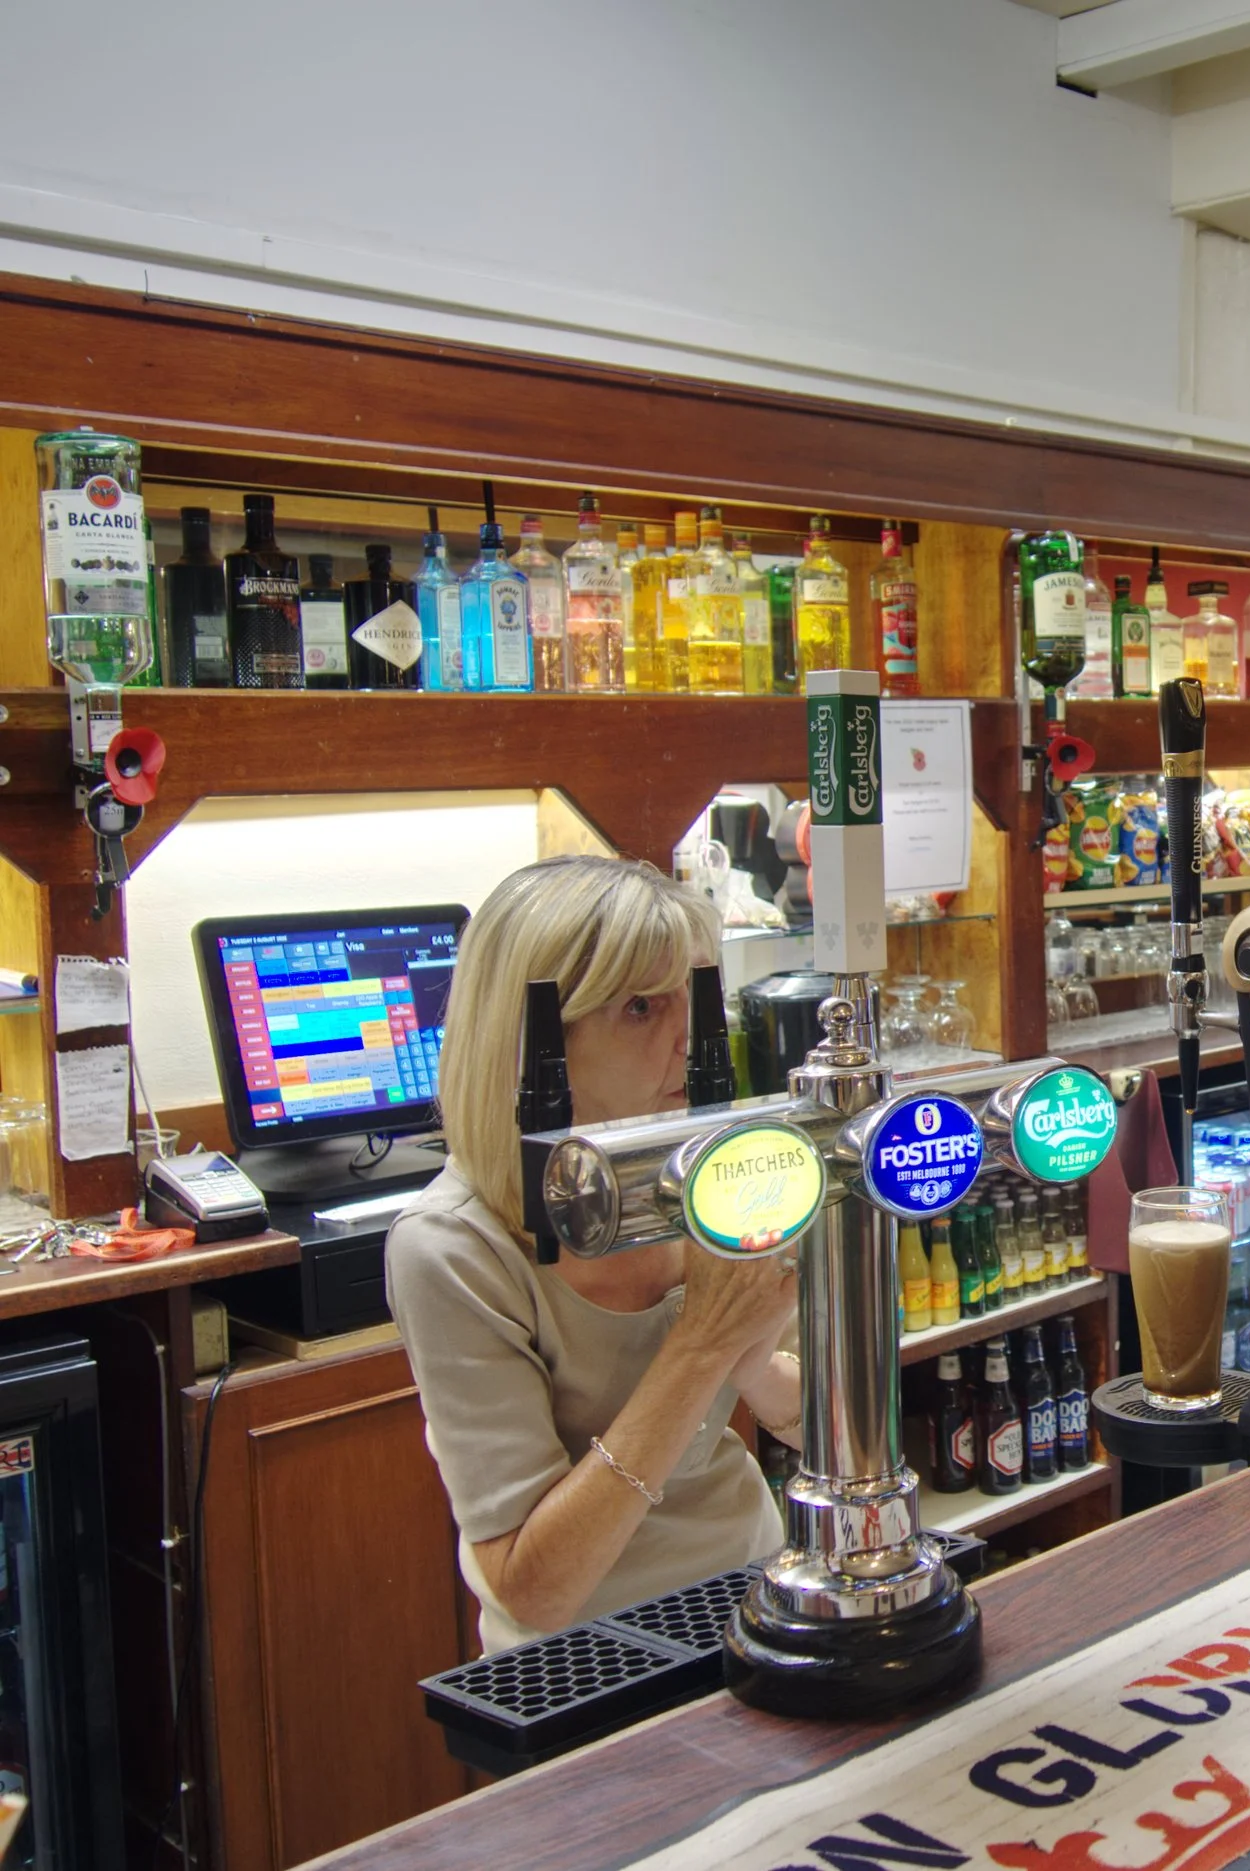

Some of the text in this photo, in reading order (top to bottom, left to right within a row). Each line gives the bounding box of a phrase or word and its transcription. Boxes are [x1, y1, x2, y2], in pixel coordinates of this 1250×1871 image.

[68, 512, 138, 530] BACARDÍ
[811, 704, 836, 817] Carlsberg
[847, 704, 876, 816] Carlsberg
[1190, 795, 1202, 874] GUINNESS
[345, 941, 365, 952] Visa
[1023, 1096, 1116, 1142] Carlsberg
[712, 1147, 806, 1182] THATCHERS
[880, 1133, 980, 1170] FOSTER'S
[1048, 1149, 1098, 1167] PILSNER
[912, 1165, 950, 1180] MELBOURNE
